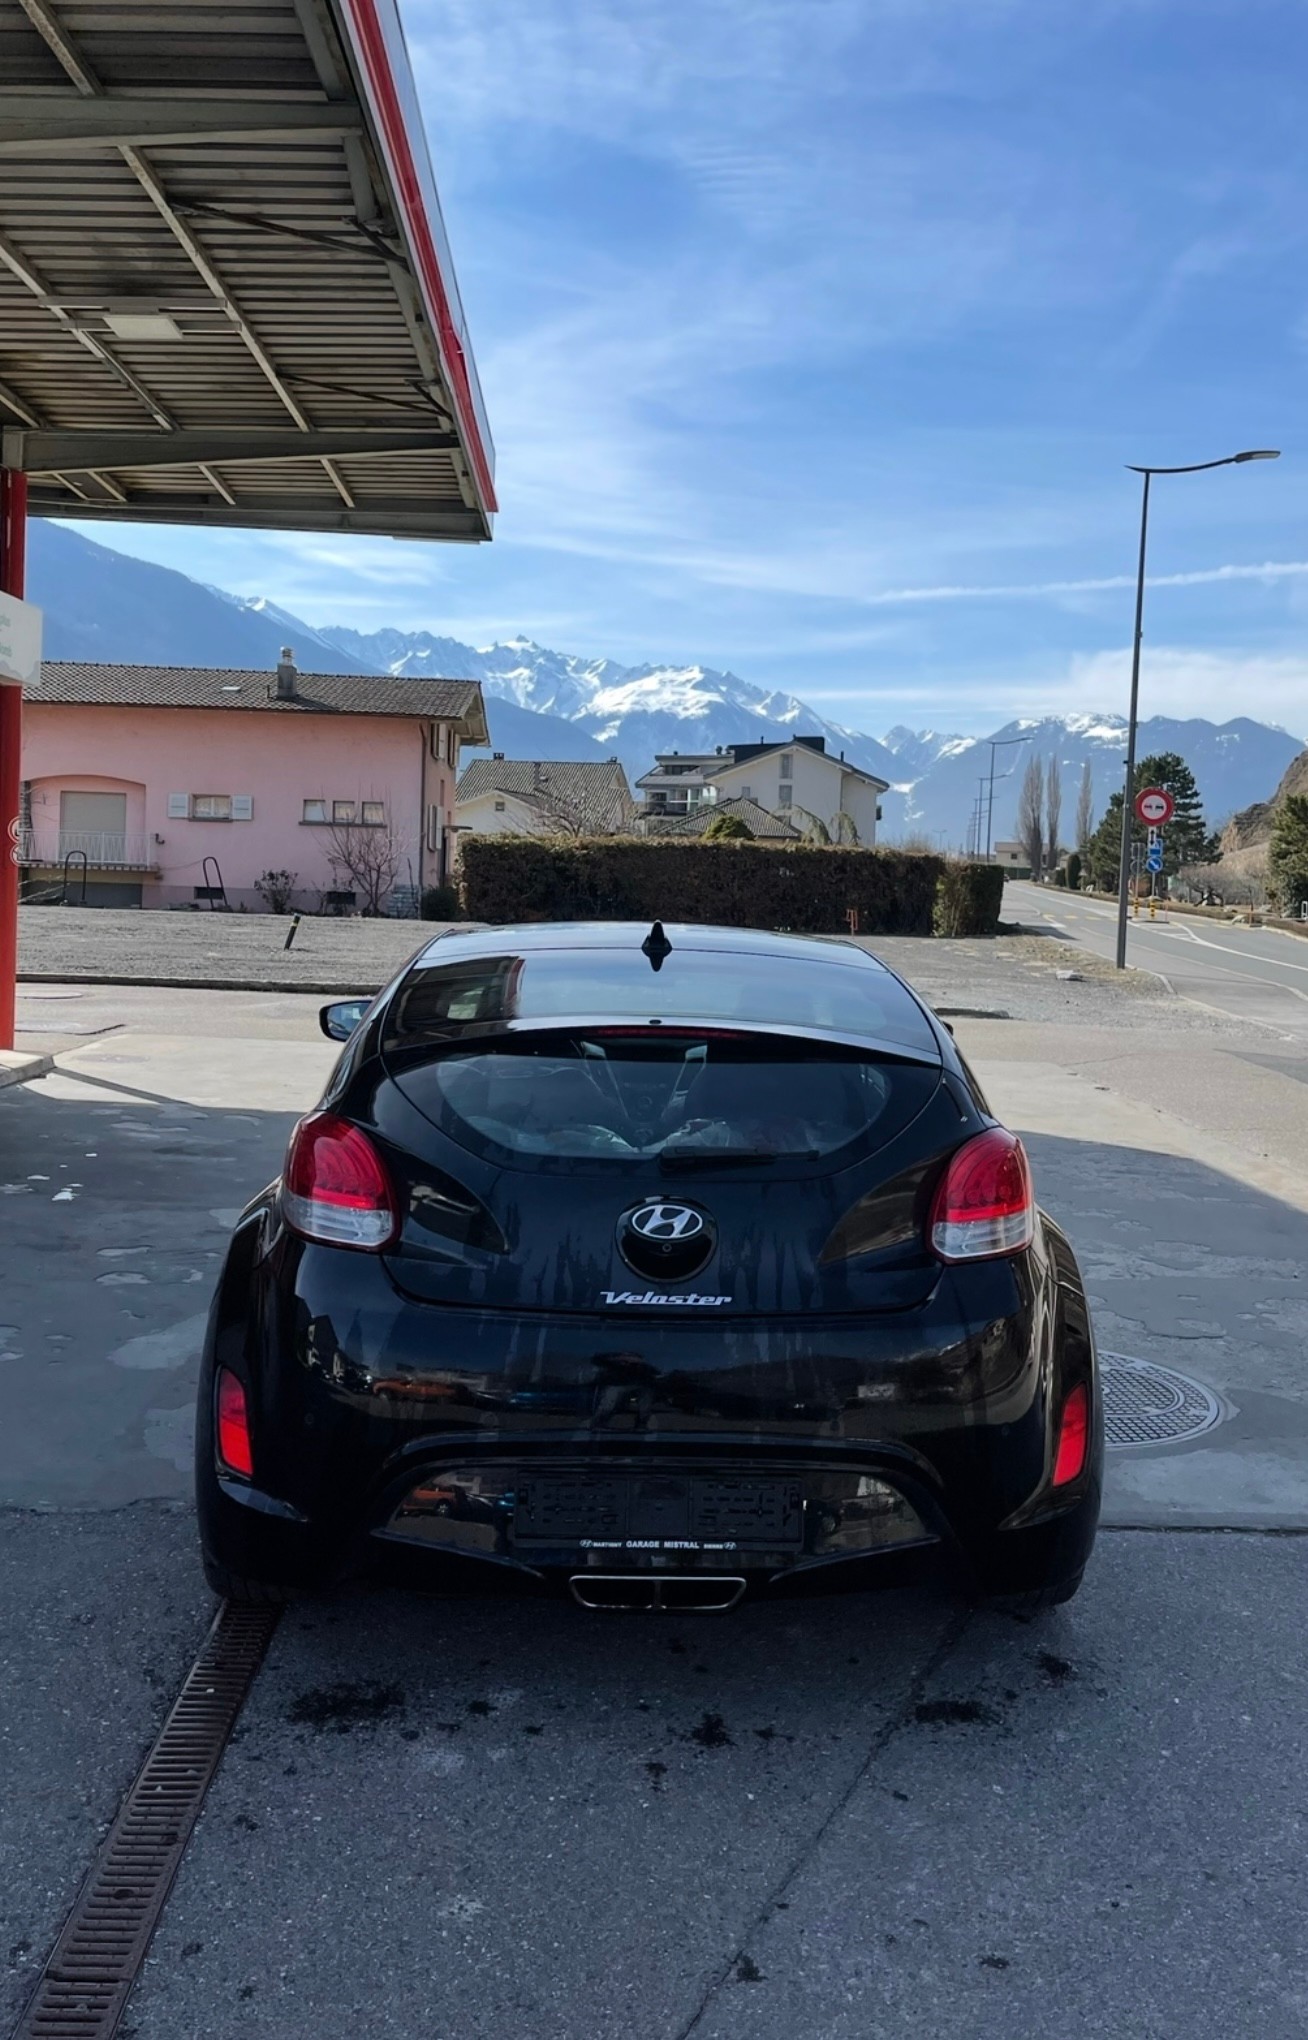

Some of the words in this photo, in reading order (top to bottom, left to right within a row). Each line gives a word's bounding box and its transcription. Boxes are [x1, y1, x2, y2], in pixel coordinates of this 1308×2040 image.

[600, 1291, 732, 1306] Veloster
[626, 1540, 660, 1549] GARAGE
[664, 1541, 700, 1549] MISTRAL
